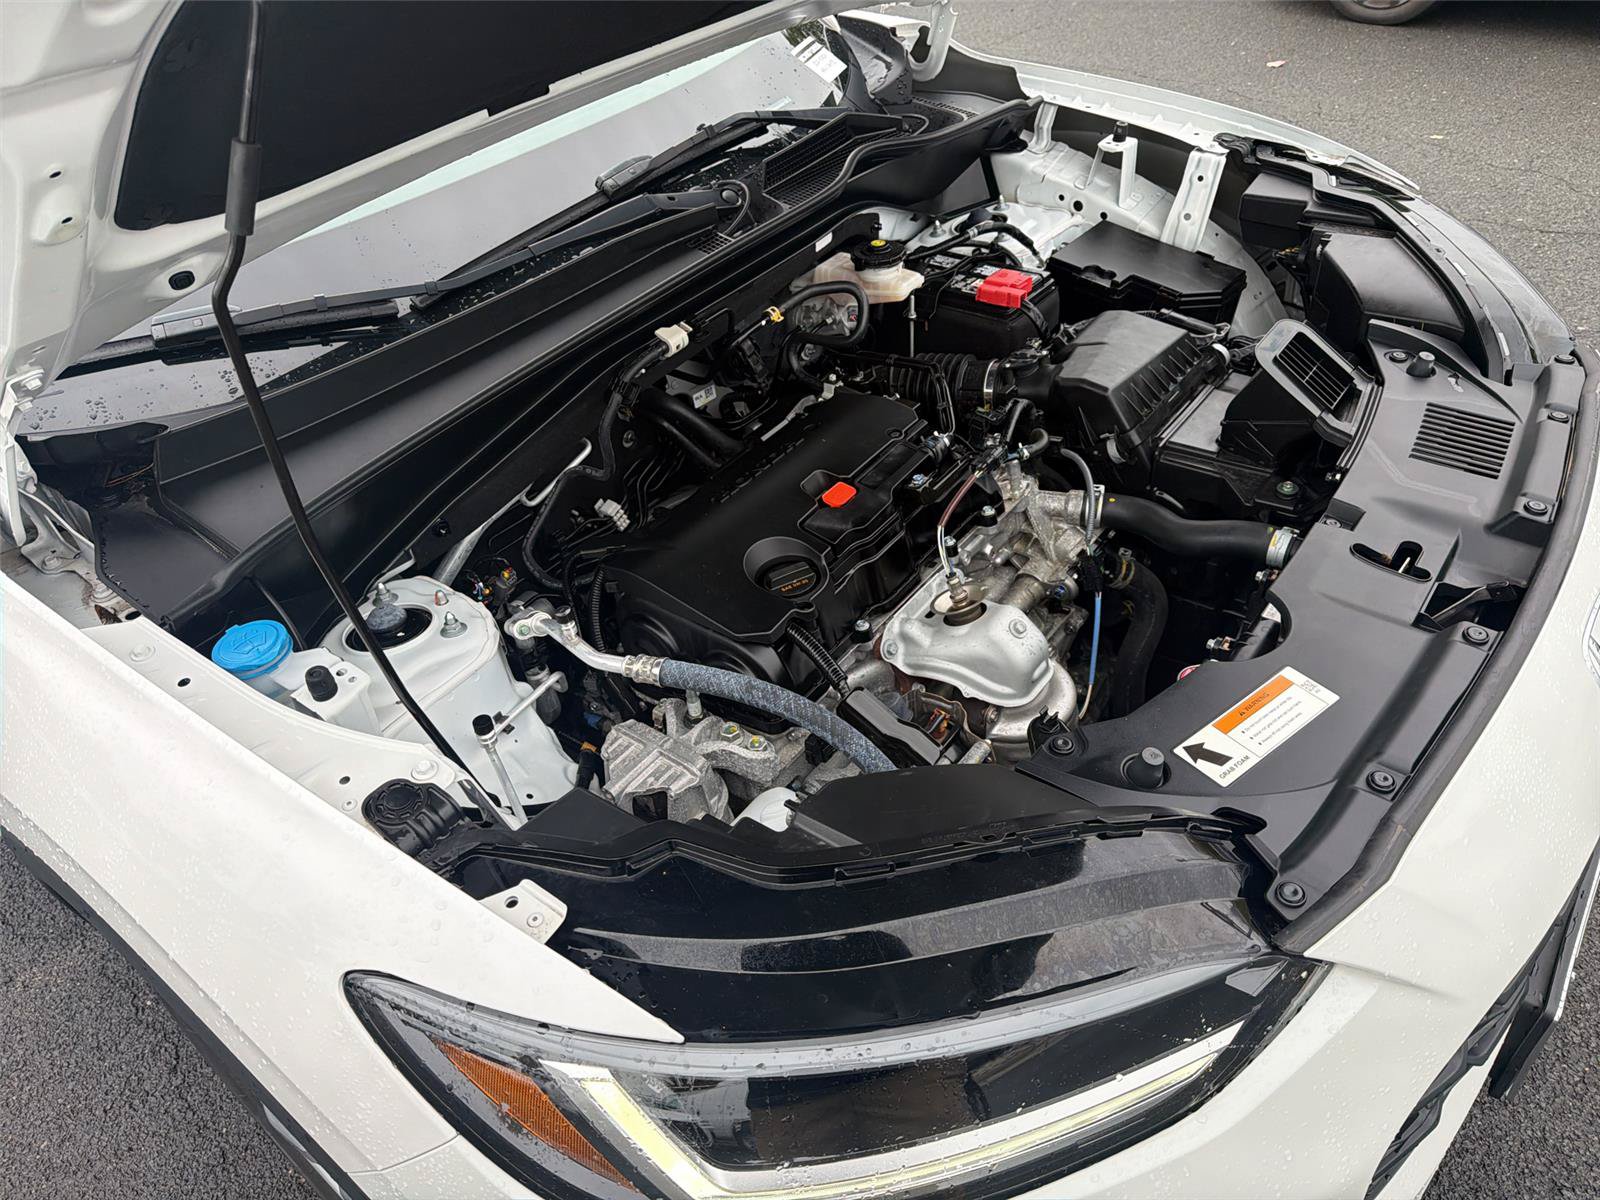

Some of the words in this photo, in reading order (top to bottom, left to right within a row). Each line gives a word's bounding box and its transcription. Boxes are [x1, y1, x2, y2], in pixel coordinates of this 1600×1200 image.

[1245, 692, 1270, 711] WARNING
[1219, 766, 1236, 779] GRAB
[1234, 754, 1250, 768] FOAM
